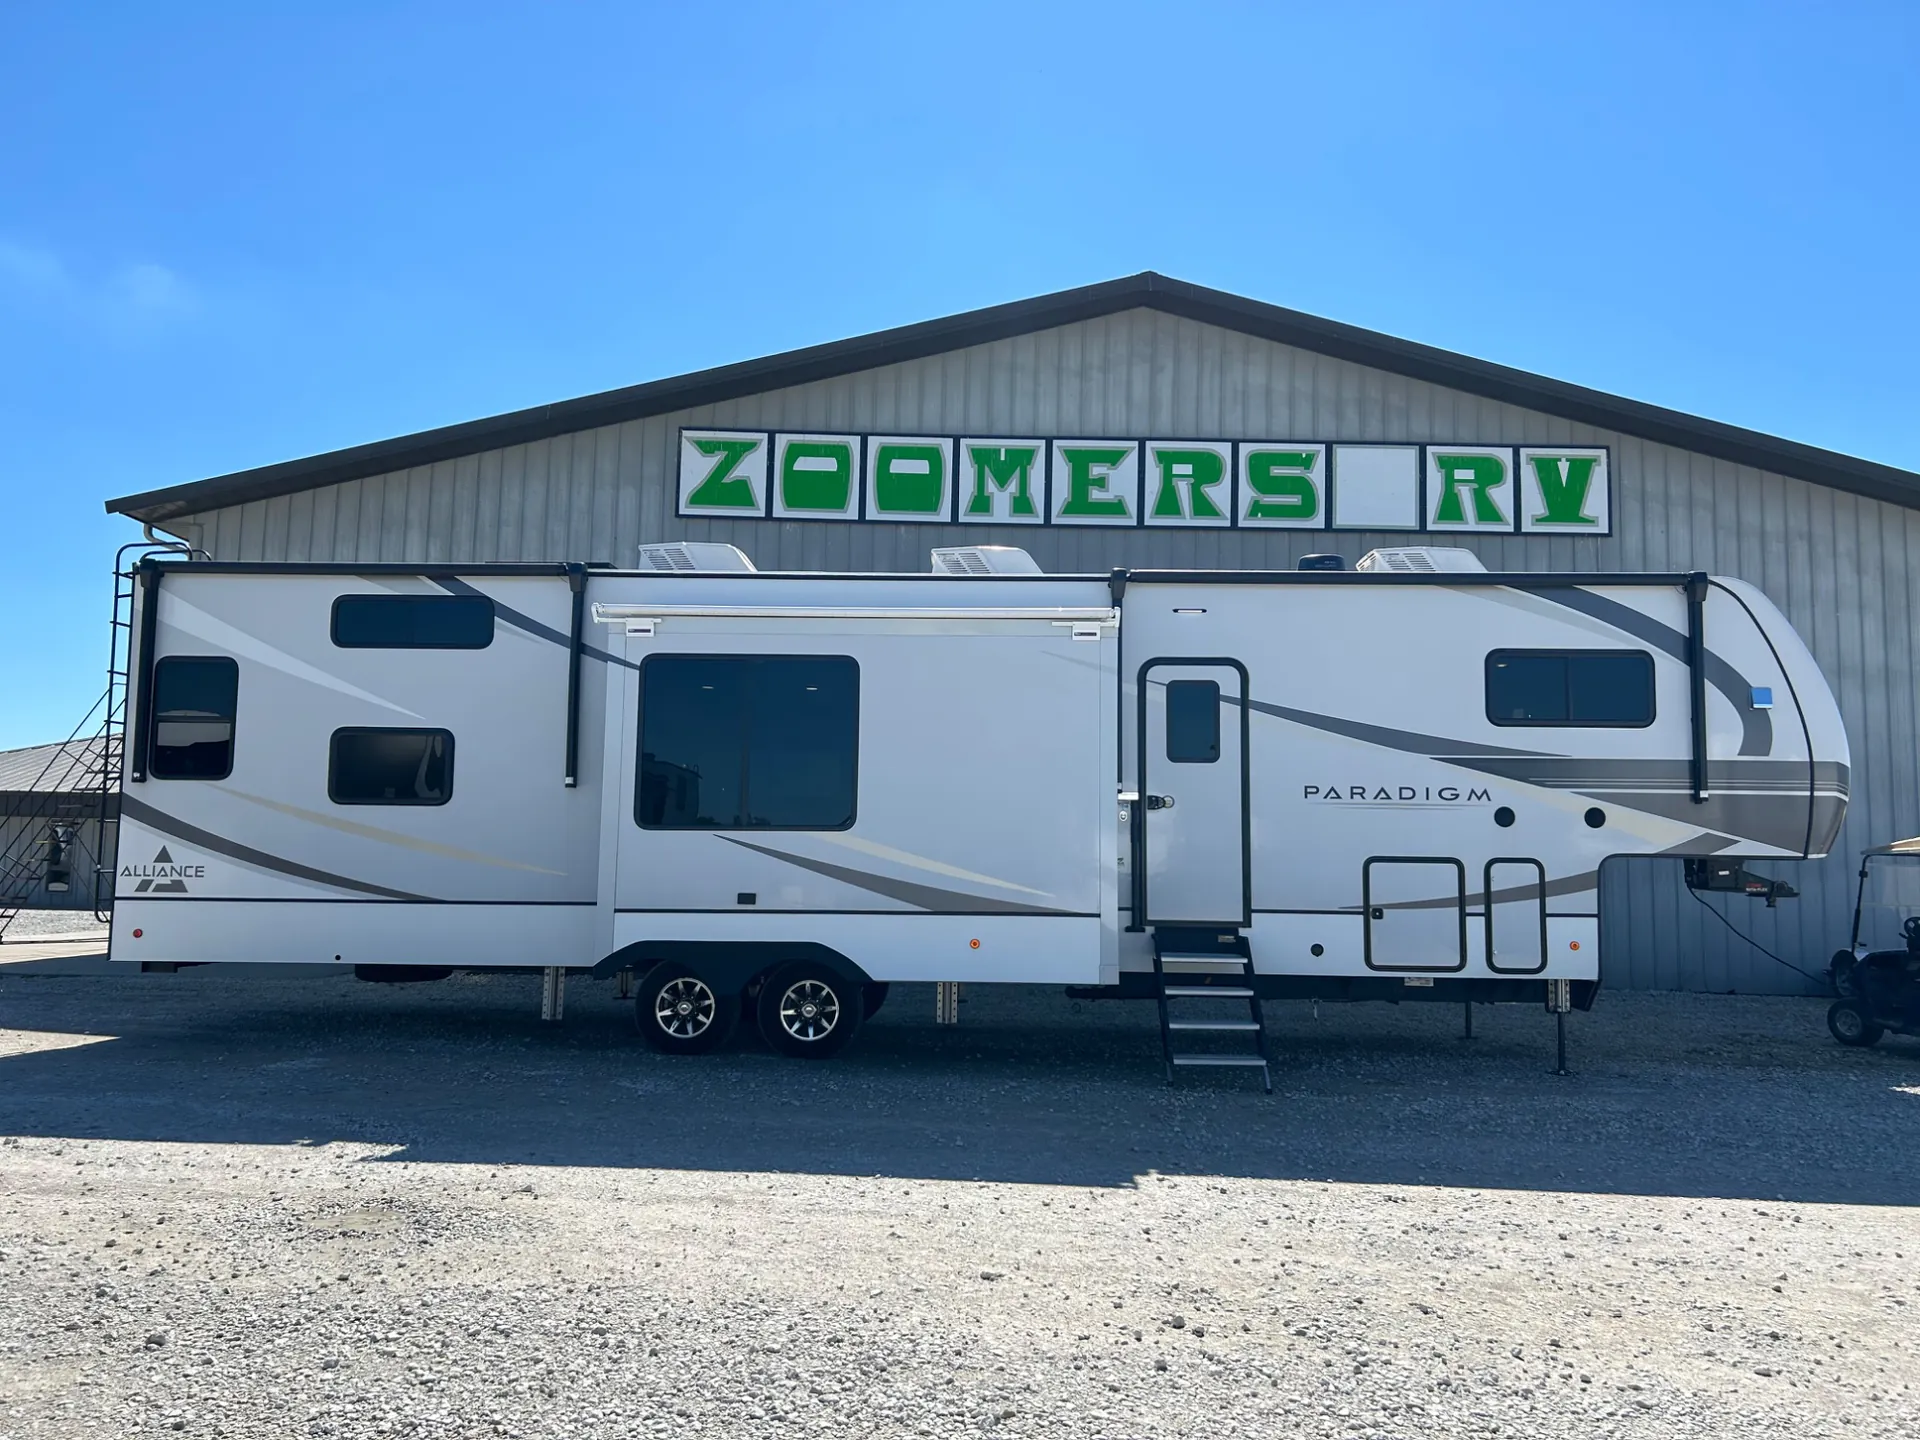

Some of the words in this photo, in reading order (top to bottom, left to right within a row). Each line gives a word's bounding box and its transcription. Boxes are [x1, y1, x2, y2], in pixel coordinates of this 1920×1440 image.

[685, 437, 1320, 520] ZOOMERS
[1434, 453, 1600, 526] RV
[1304, 785, 1492, 802] PARADIGM
[120, 865, 205, 878] ALLIANCE
